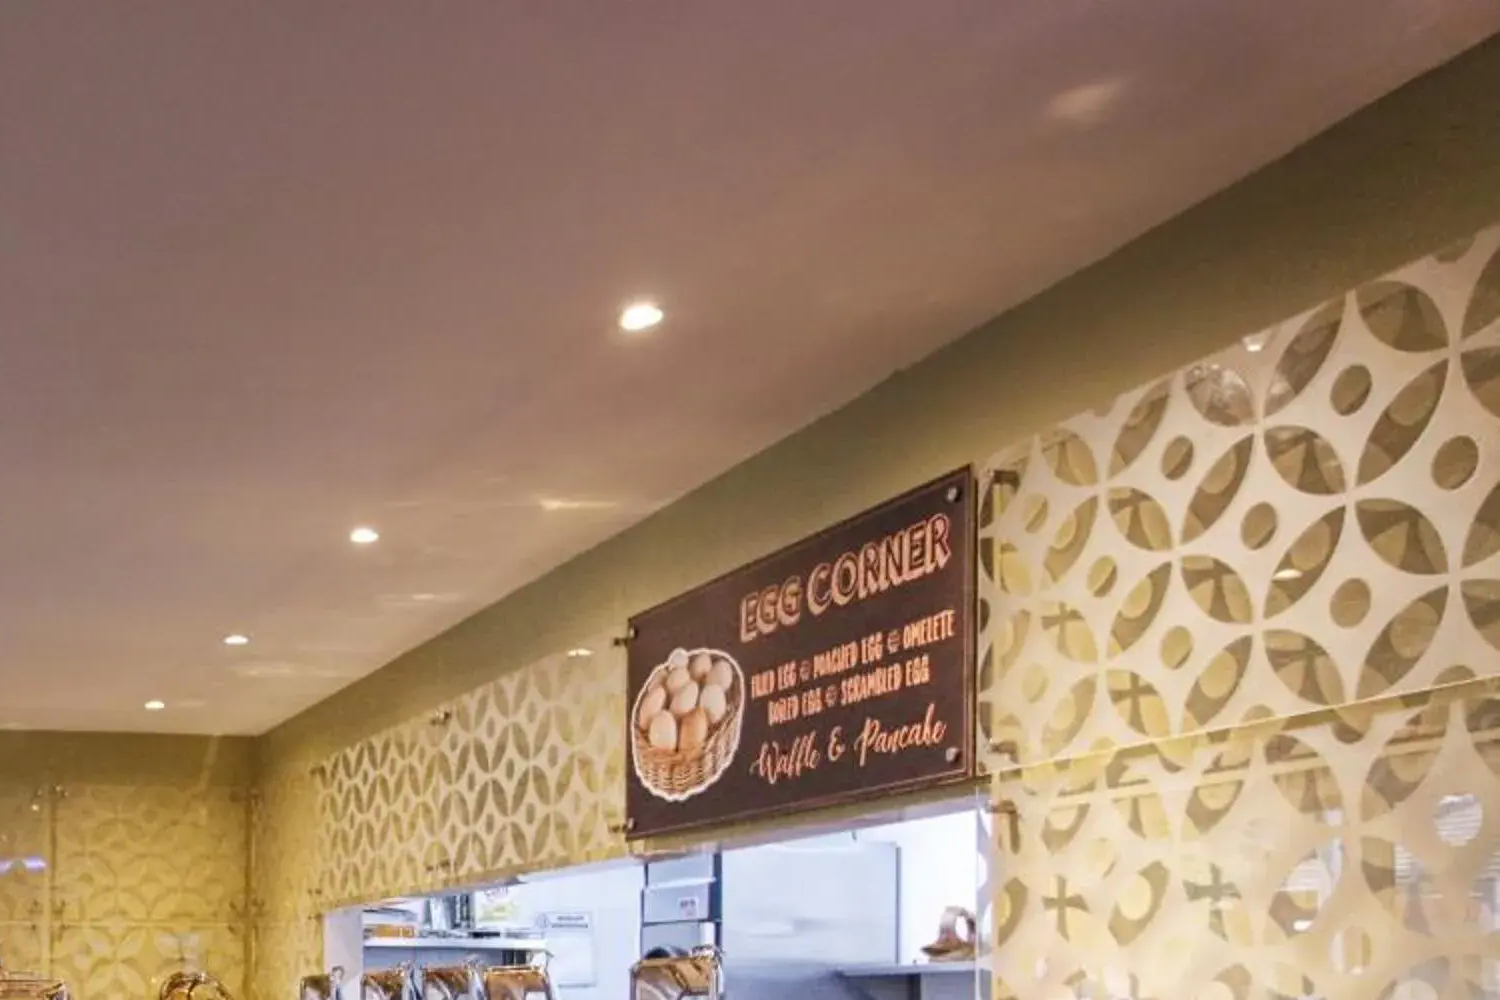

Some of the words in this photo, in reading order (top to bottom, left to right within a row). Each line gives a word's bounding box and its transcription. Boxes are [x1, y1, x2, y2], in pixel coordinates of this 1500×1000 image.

[740, 576, 802, 643] EGG
[806, 513, 952, 616] CORNER
[778, 661, 797, 691] EGG
[862, 632, 883, 664] EGG
[802, 687, 823, 716] EGG
[841, 663, 901, 705] SCRAMBLED
[905, 653, 930, 686] EGG
[749, 730, 821, 785] Waffle
[828, 725, 845, 761] &
[854, 702, 948, 767] Pancake
